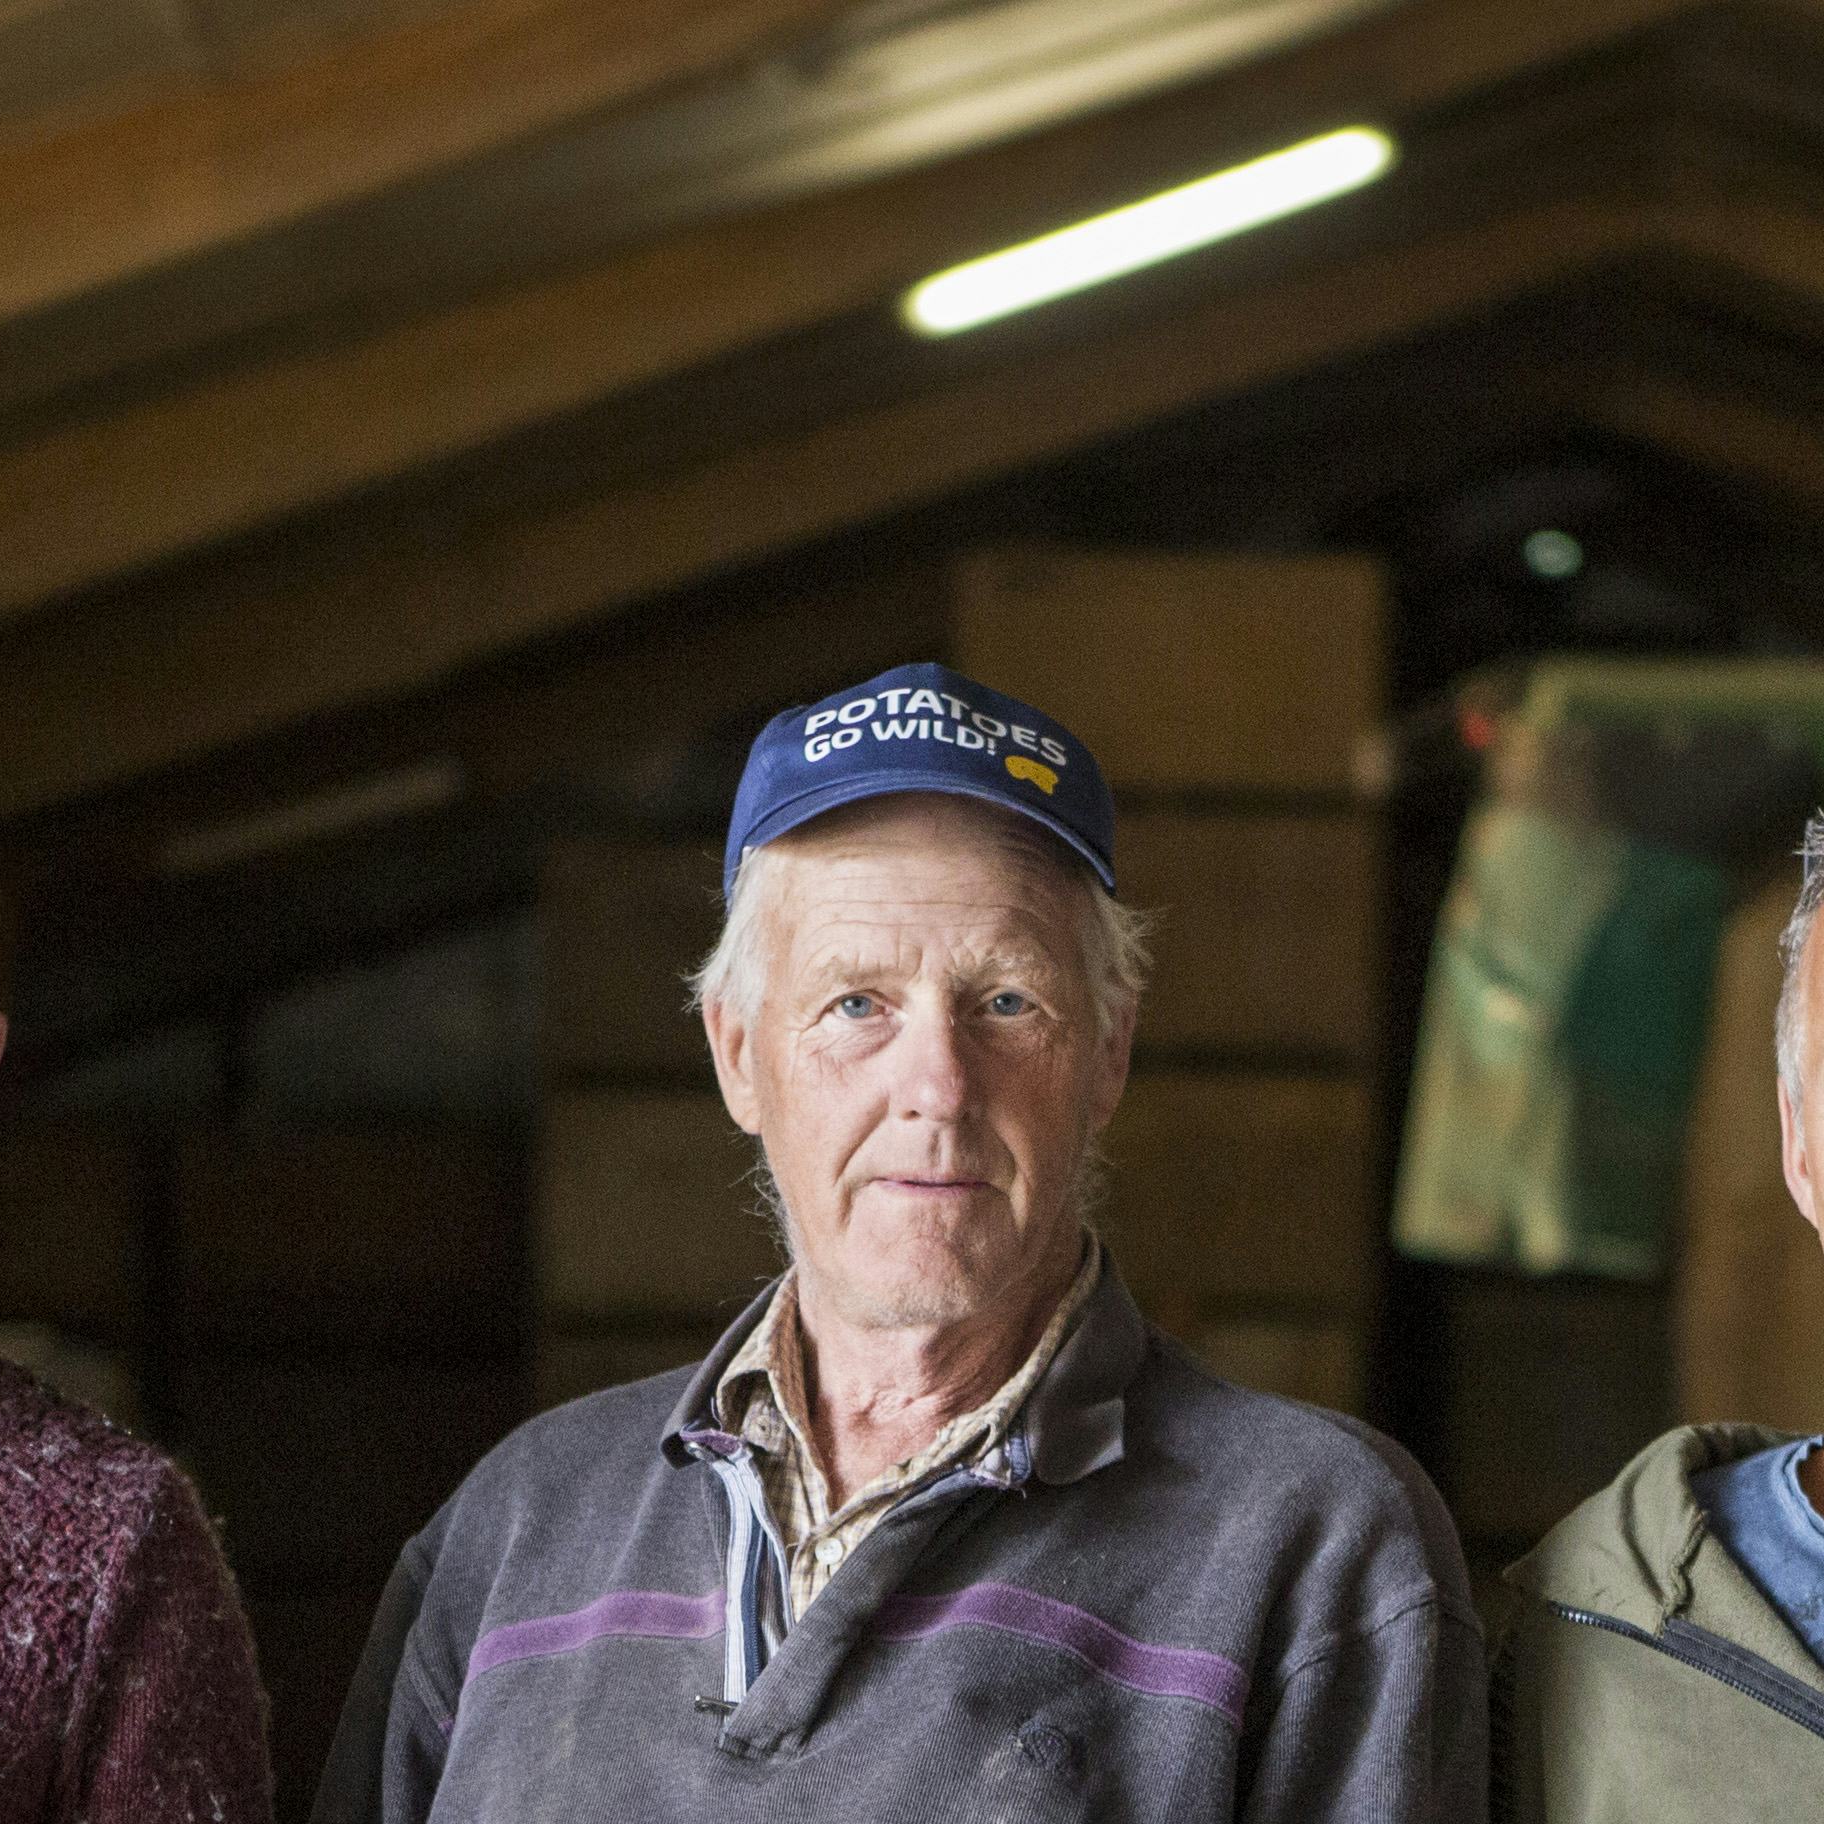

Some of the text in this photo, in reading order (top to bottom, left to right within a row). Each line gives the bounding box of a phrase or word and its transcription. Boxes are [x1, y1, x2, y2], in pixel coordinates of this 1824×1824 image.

[804, 688, 1067, 766] POTATOES
[804, 719, 996, 763] GO WILD!
